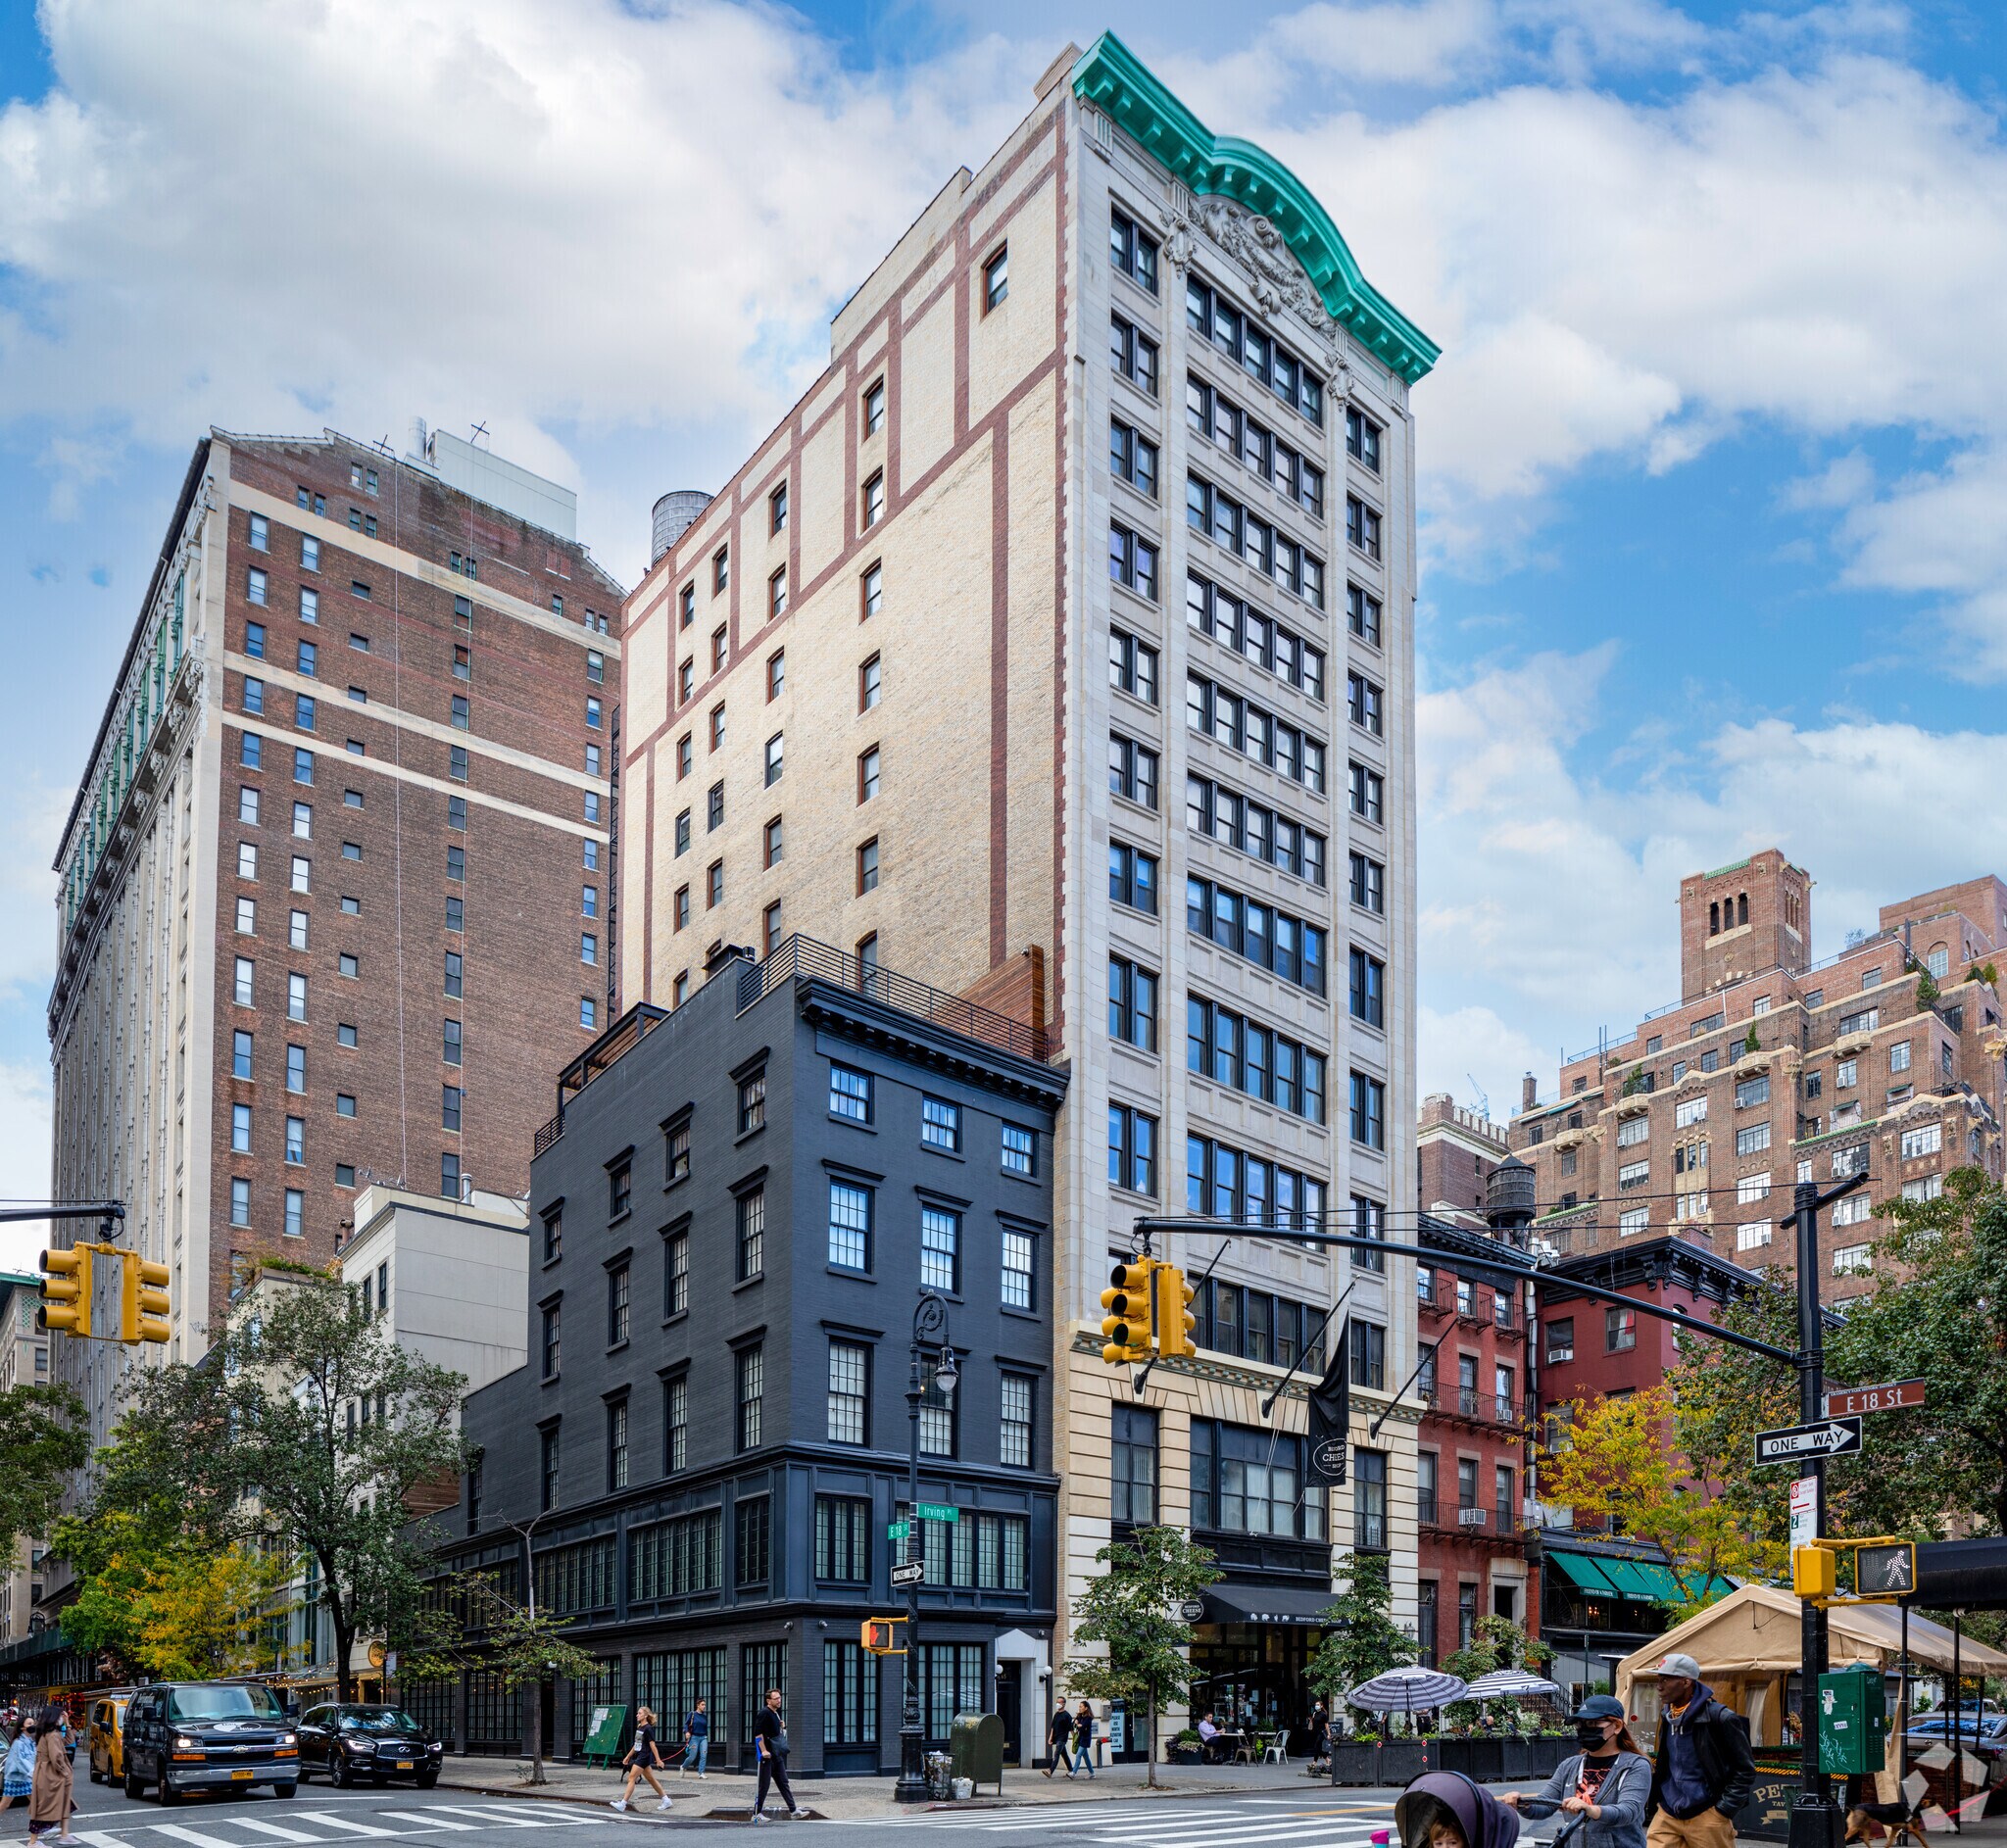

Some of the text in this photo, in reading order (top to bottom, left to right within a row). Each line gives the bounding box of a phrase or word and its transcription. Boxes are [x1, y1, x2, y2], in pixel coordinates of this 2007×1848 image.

[1846, 1387, 1903, 1412] E 18 St
[1770, 1430, 1844, 1453] ONE WAY
[1322, 1452, 1345, 1461] CHEES
[924, 1506, 946, 1521] Irving
[1792, 1515, 1797, 1529] 2
[890, 1526, 894, 1537] E
[895, 1525, 902, 1536] 18
[895, 1571, 906, 1579] ONE
